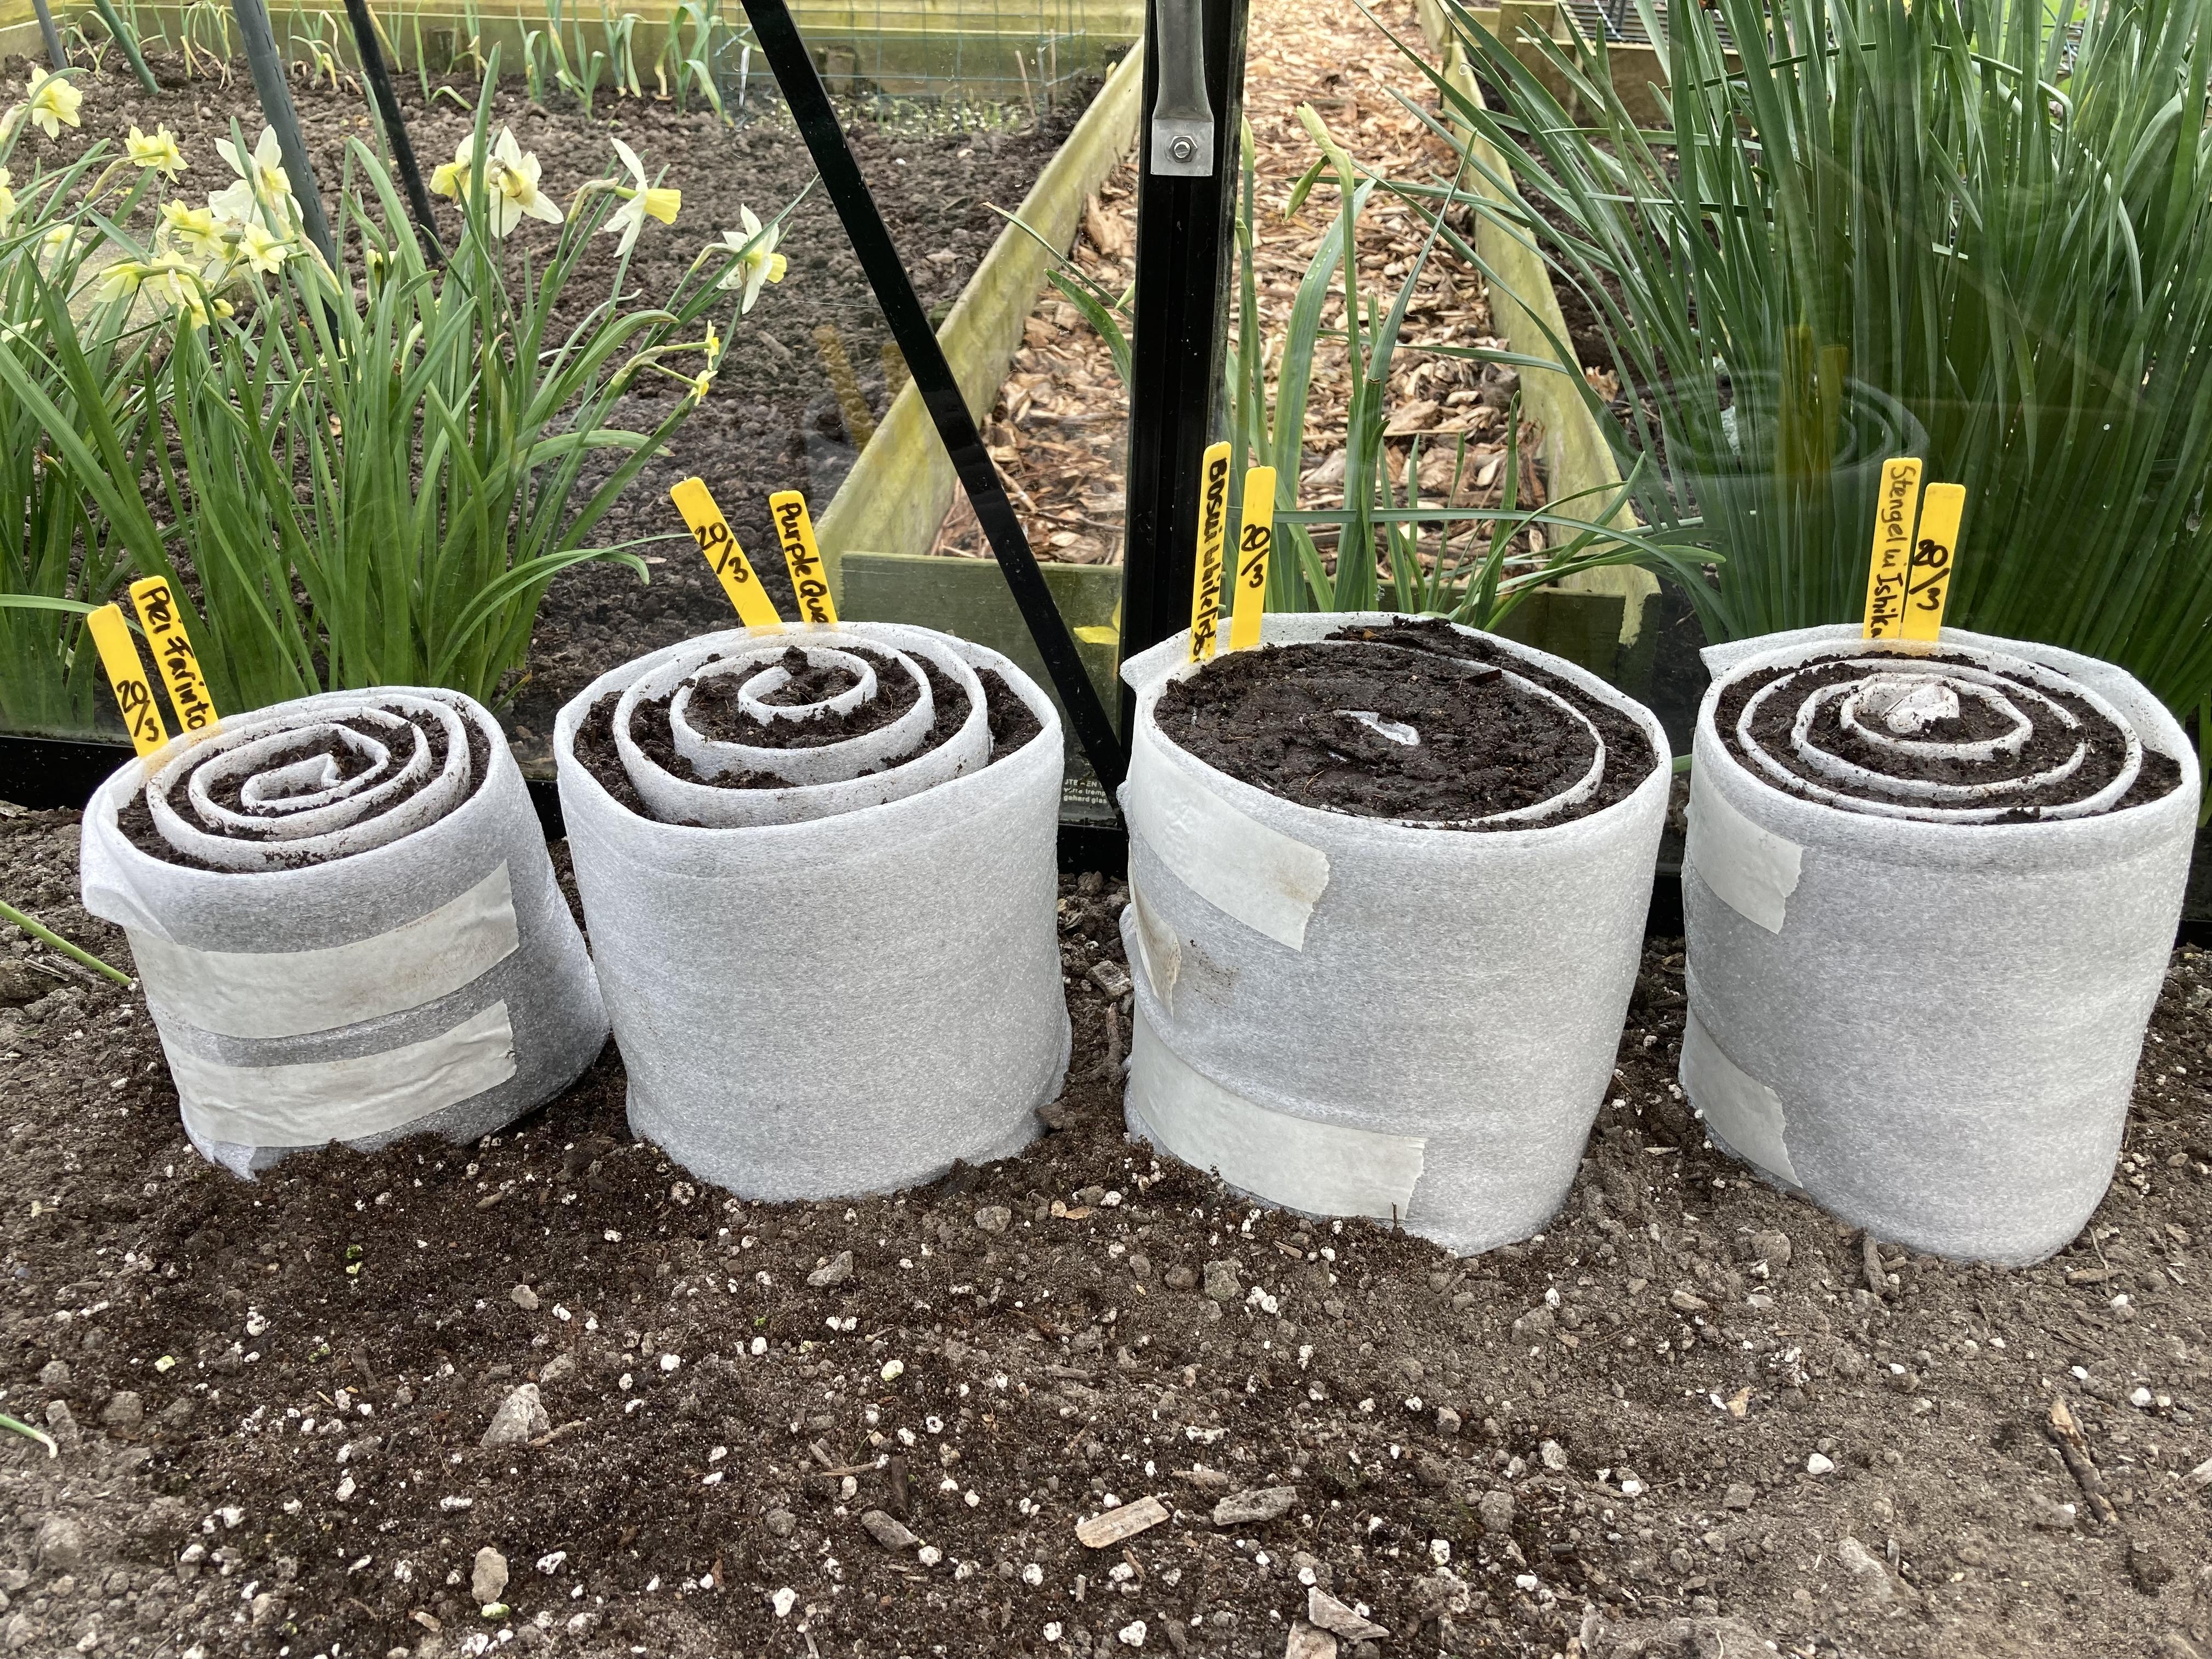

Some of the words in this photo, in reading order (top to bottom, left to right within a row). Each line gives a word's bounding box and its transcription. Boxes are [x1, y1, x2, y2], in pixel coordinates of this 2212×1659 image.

[694, 522, 749, 584] 20/3
[776, 502, 820, 578] Purple
[1241, 523, 1271, 589] 20/3
[1908, 538, 1950, 611] 20/3
[116, 680, 159, 742] 20/3
[164, 635, 210, 730] Farinto
